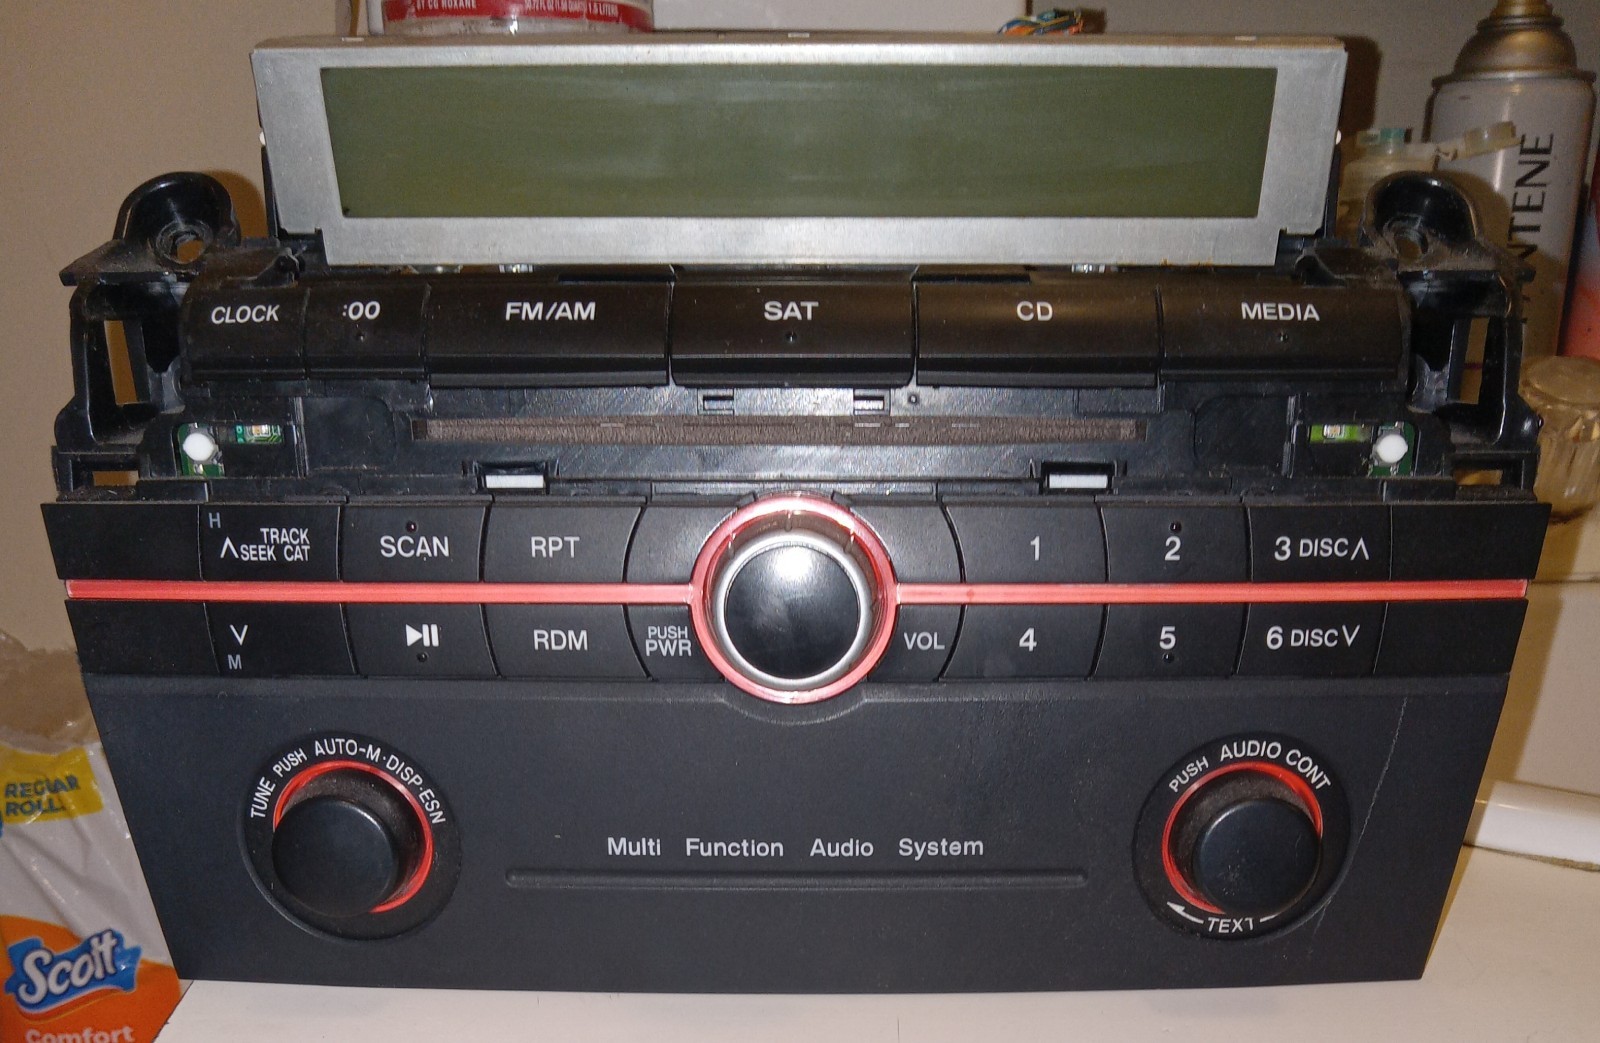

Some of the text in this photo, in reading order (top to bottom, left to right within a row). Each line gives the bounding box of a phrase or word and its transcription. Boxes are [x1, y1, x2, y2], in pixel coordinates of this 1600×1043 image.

[1507, 133, 1554, 324] NTENE
[210, 304, 280, 325] CLOCK
[505, 301, 596, 321] FM/AM
[764, 300, 819, 321] SAT
[1016, 301, 1054, 321] CD
[1241, 302, 1320, 321] MEDIA
[208, 512, 221, 529] H
[259, 527, 310, 545] TRACK
[380, 535, 450, 558] SCAN
[240, 544, 311, 561] SEEK CAT
[530, 536, 580, 558] RPT
[1030, 535, 1041, 561] 1
[1164, 536, 1181, 561] 2
[1274, 536, 1349, 561] 3 DISC
[533, 629, 588, 651] RDM
[647, 625, 689, 639] PUSH
[903, 631, 945, 651] VOL
[1019, 627, 1038, 652] 4
[1159, 626, 1176, 650] 5
[1266, 625, 1339, 650] 6 DISC
[645, 639, 692, 657] PWR
[227, 654, 243, 670] M
[1168, 739, 1332, 793] PUSH AUDIO CONT
[250, 777, 276, 819] TUNE
[272, 748, 308, 777] PUSH
[607, 837, 984, 862] Multi Function Audio System
[1207, 917, 1255, 933] TEXT
[18, 930, 117, 1005] Scott
[25, 1026, 135, 1043] Comfort
